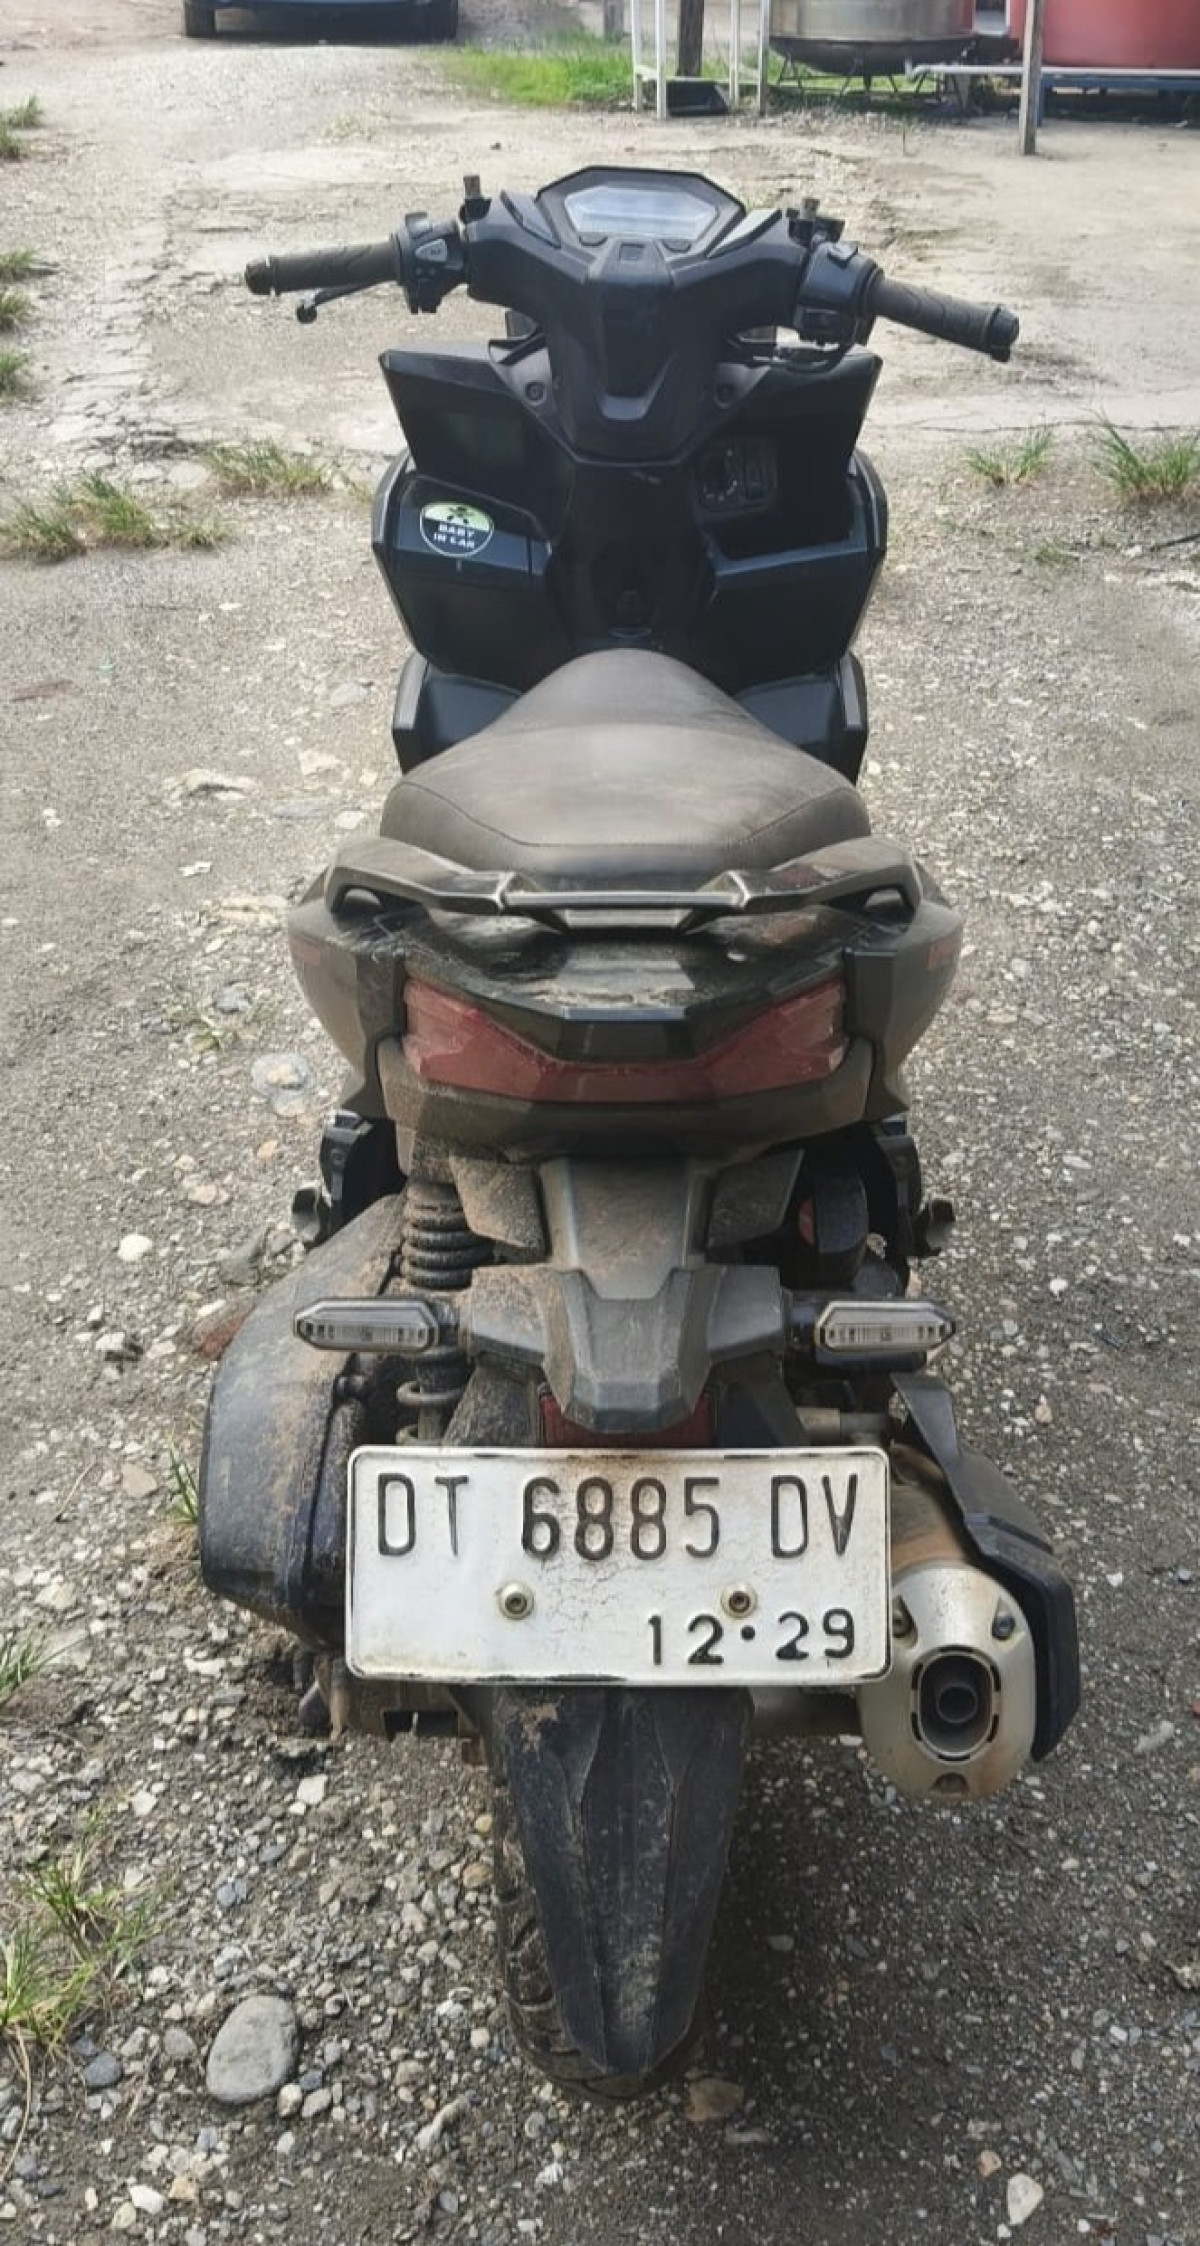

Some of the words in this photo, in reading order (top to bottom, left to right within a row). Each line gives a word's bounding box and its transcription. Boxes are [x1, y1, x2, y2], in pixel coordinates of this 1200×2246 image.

[439, 524, 475, 539] BABY
[433, 532, 446, 543] IN
[450, 535, 475, 549] CAR
[377, 1472, 468, 1556] DT
[521, 1476, 721, 1561] 6885
[770, 1473, 858, 1559] DV
